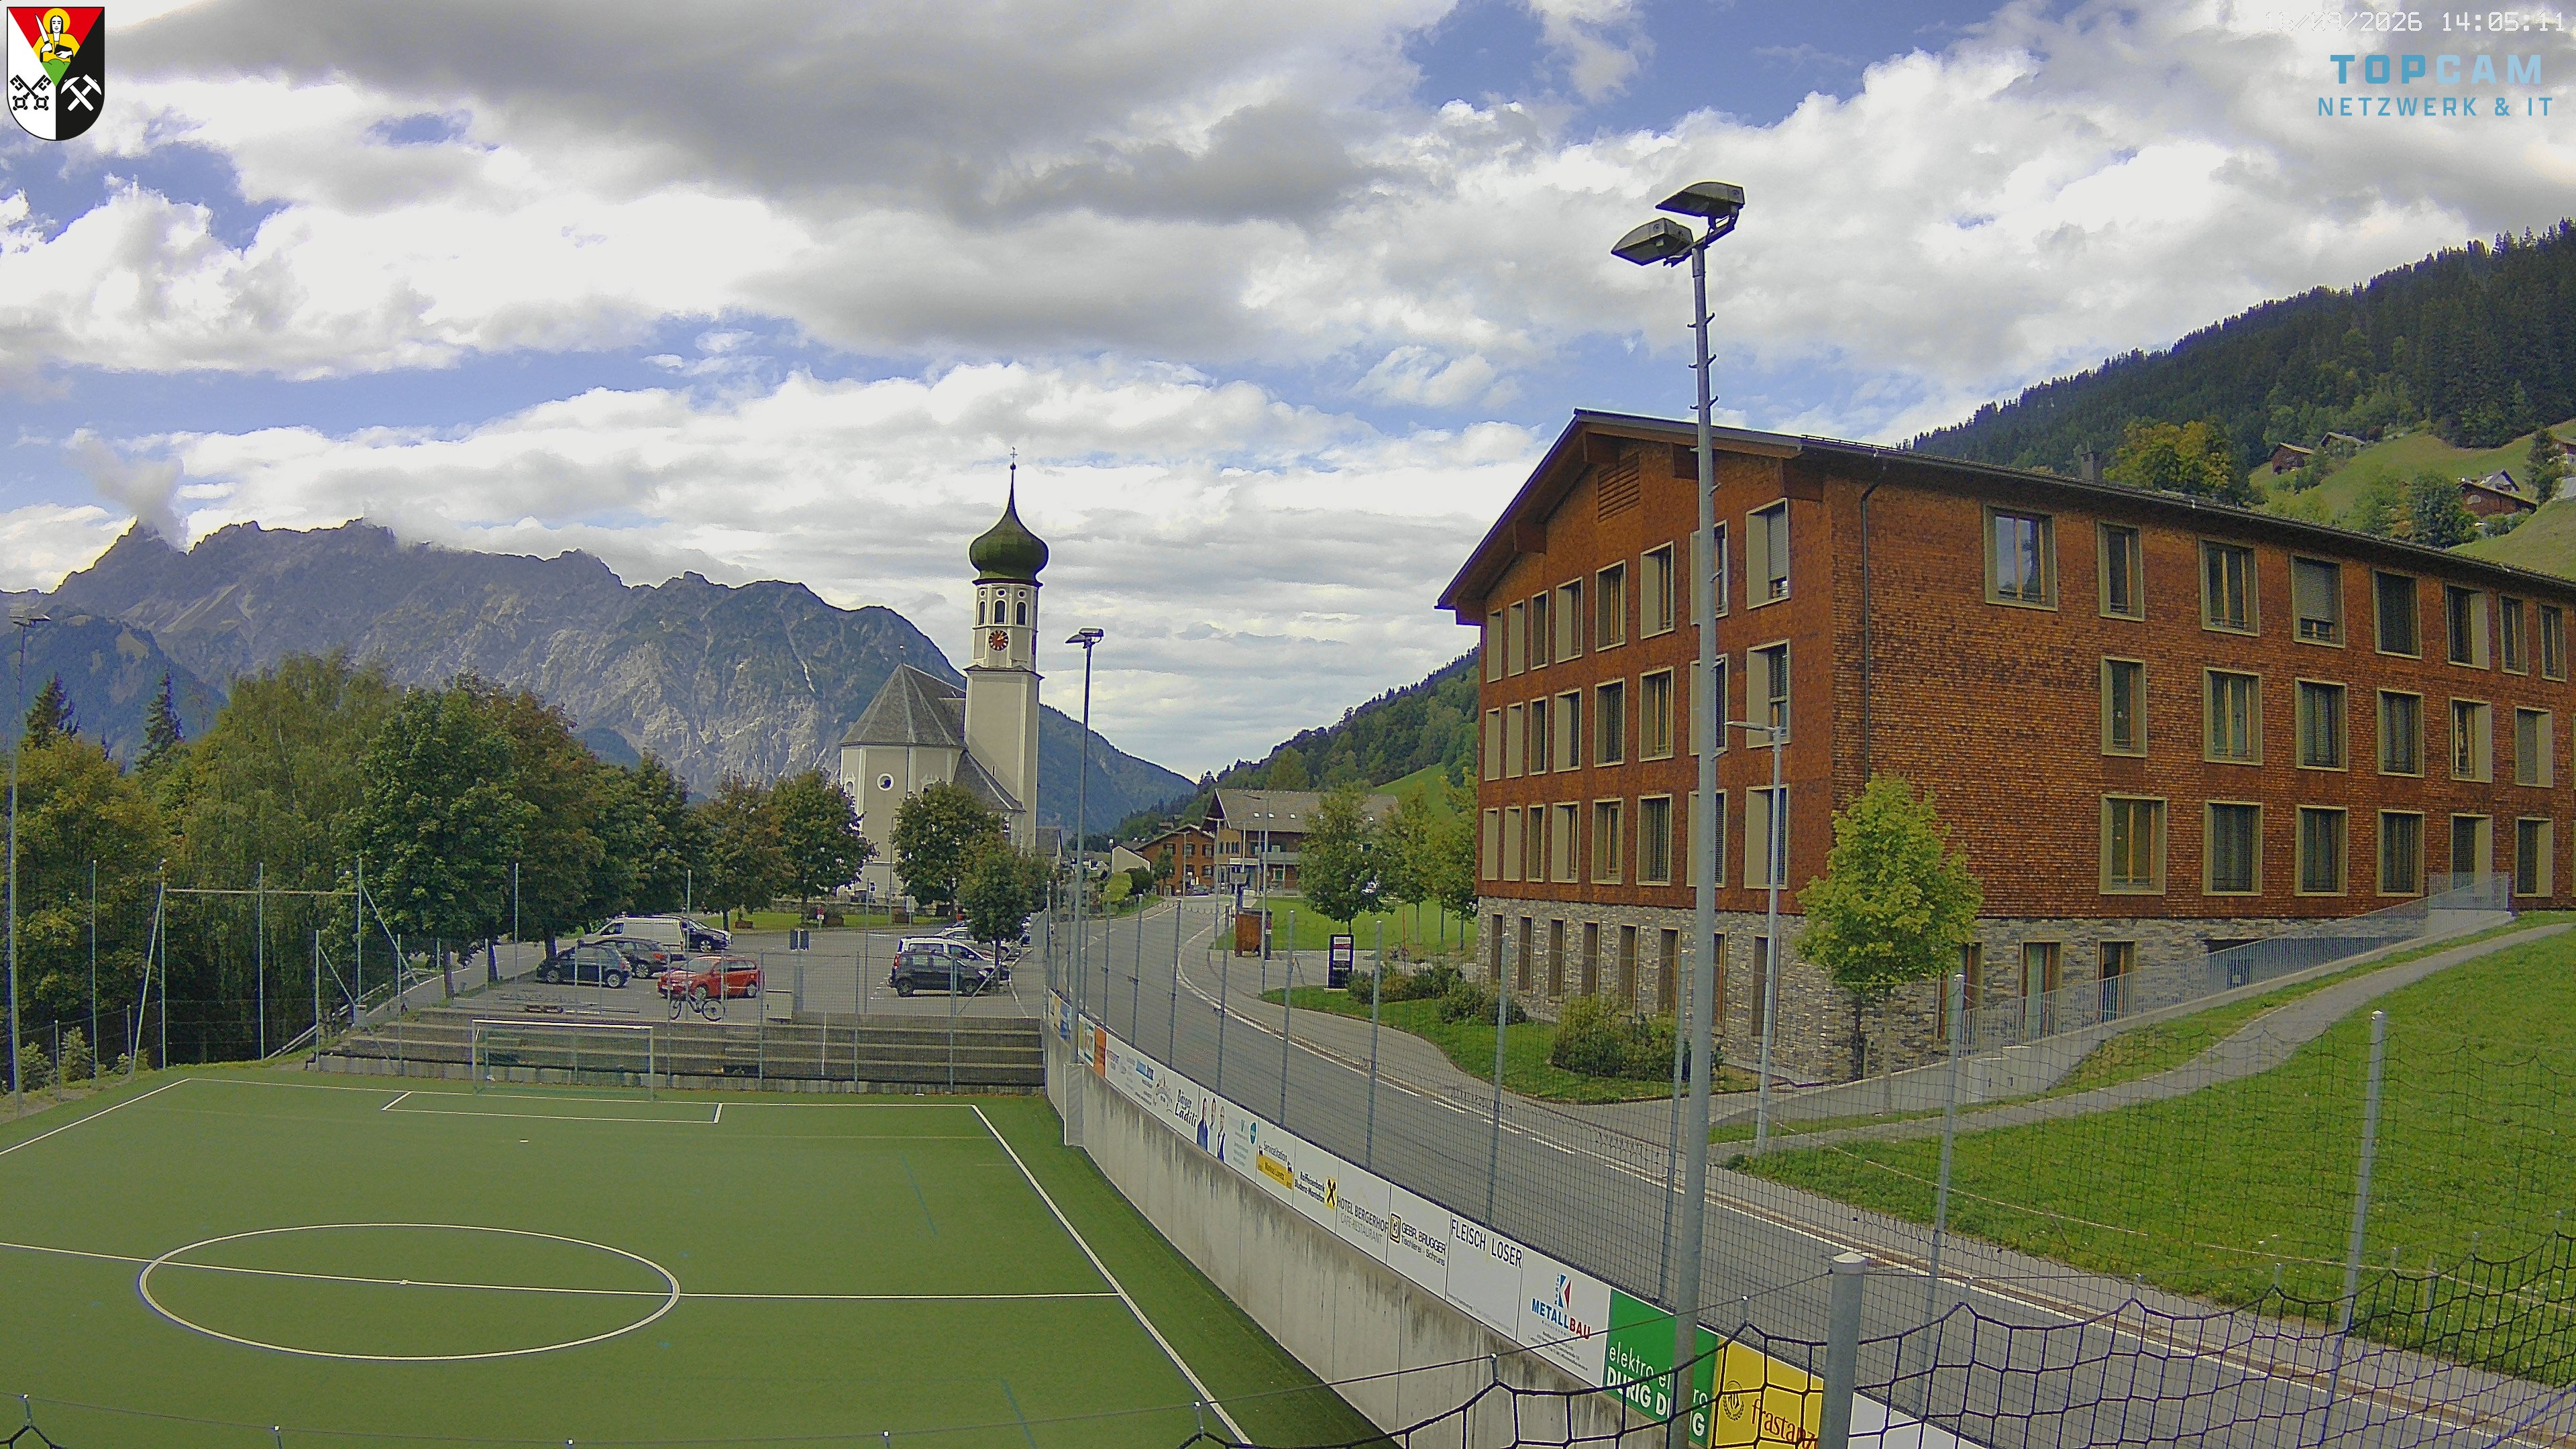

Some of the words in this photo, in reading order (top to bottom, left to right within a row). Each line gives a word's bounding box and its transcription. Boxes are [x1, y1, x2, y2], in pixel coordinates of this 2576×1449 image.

[1337, 1196, 1354, 1218] HOTEL
[1354, 1205, 1389, 1234] BERGERHOF
[1401, 1222, 1417, 1240] GEBR.
[1418, 1232, 1446, 1255] BRUGGER
[1401, 1236, 1422, 1254] Tischlerei
[1426, 1250, 1445, 1267] Schruns
[1451, 1218, 1487, 1252] FLEISCH
[1491, 1238, 1522, 1269] LOSER
[1532, 1298, 1591, 1340] METALLBAU
[1609, 1342, 1654, 1377] elektro
